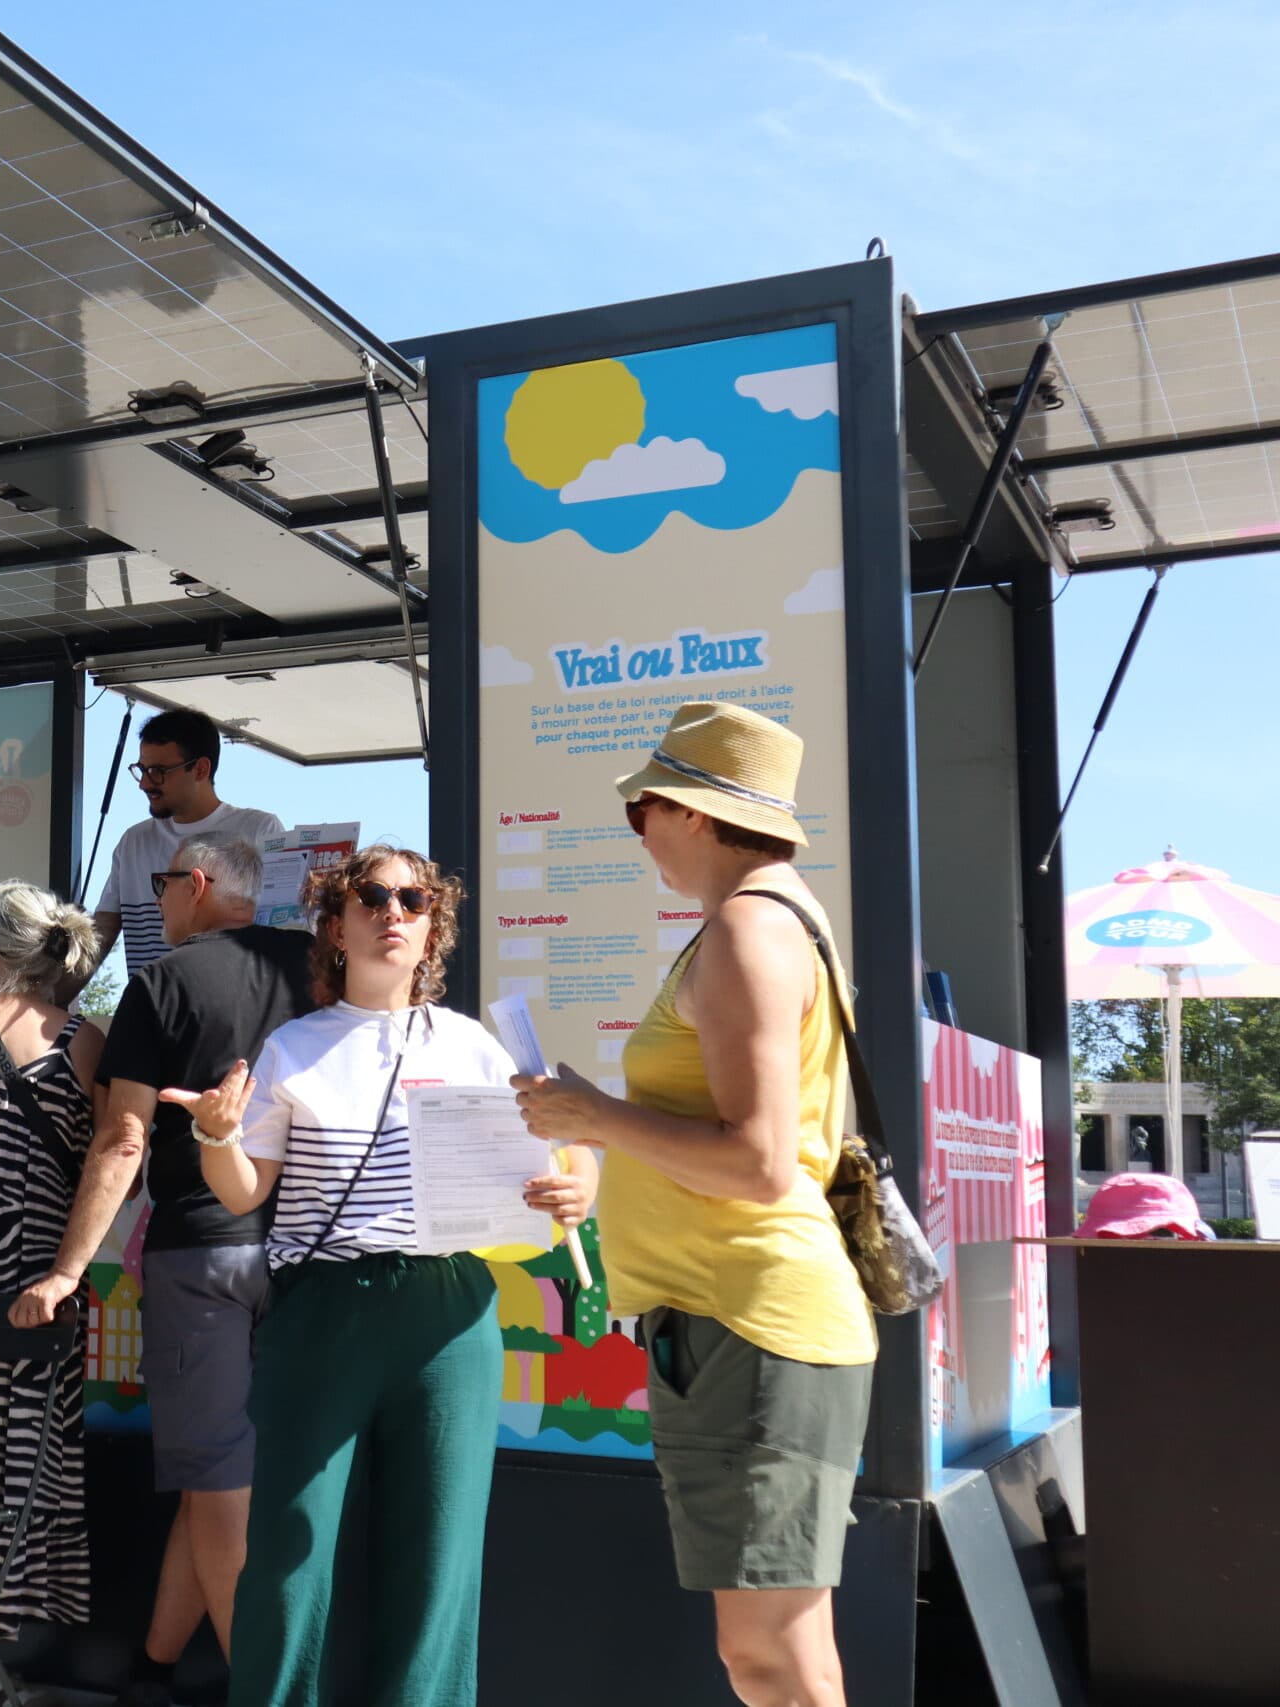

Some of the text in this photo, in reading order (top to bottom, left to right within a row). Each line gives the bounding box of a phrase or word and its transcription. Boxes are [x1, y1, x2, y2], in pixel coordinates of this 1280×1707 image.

[555, 634, 763, 688] Vrai ou Faux
[531, 684, 793, 716] Sur la base de la loi relative au droit à l'aide
[531, 720, 537, 730] à
[541, 716, 579, 729] mourir
[584, 713, 617, 725] votée
[621, 712, 639, 724] par
[644, 710, 654, 720] le
[535, 733, 562, 745] pour
[567, 729, 609, 741] chaque
[614, 725, 649, 738] point,
[568, 743, 617, 755] correcte
[622, 740, 634, 750] et
[519, 811, 560, 822] Nationalité
[498, 916, 517, 927] Type
[518, 915, 527, 925] de
[528, 914, 568, 926] pathologie
[1110, 918, 1193, 931] ADMD
[1106, 929, 1188, 941] TOUR
